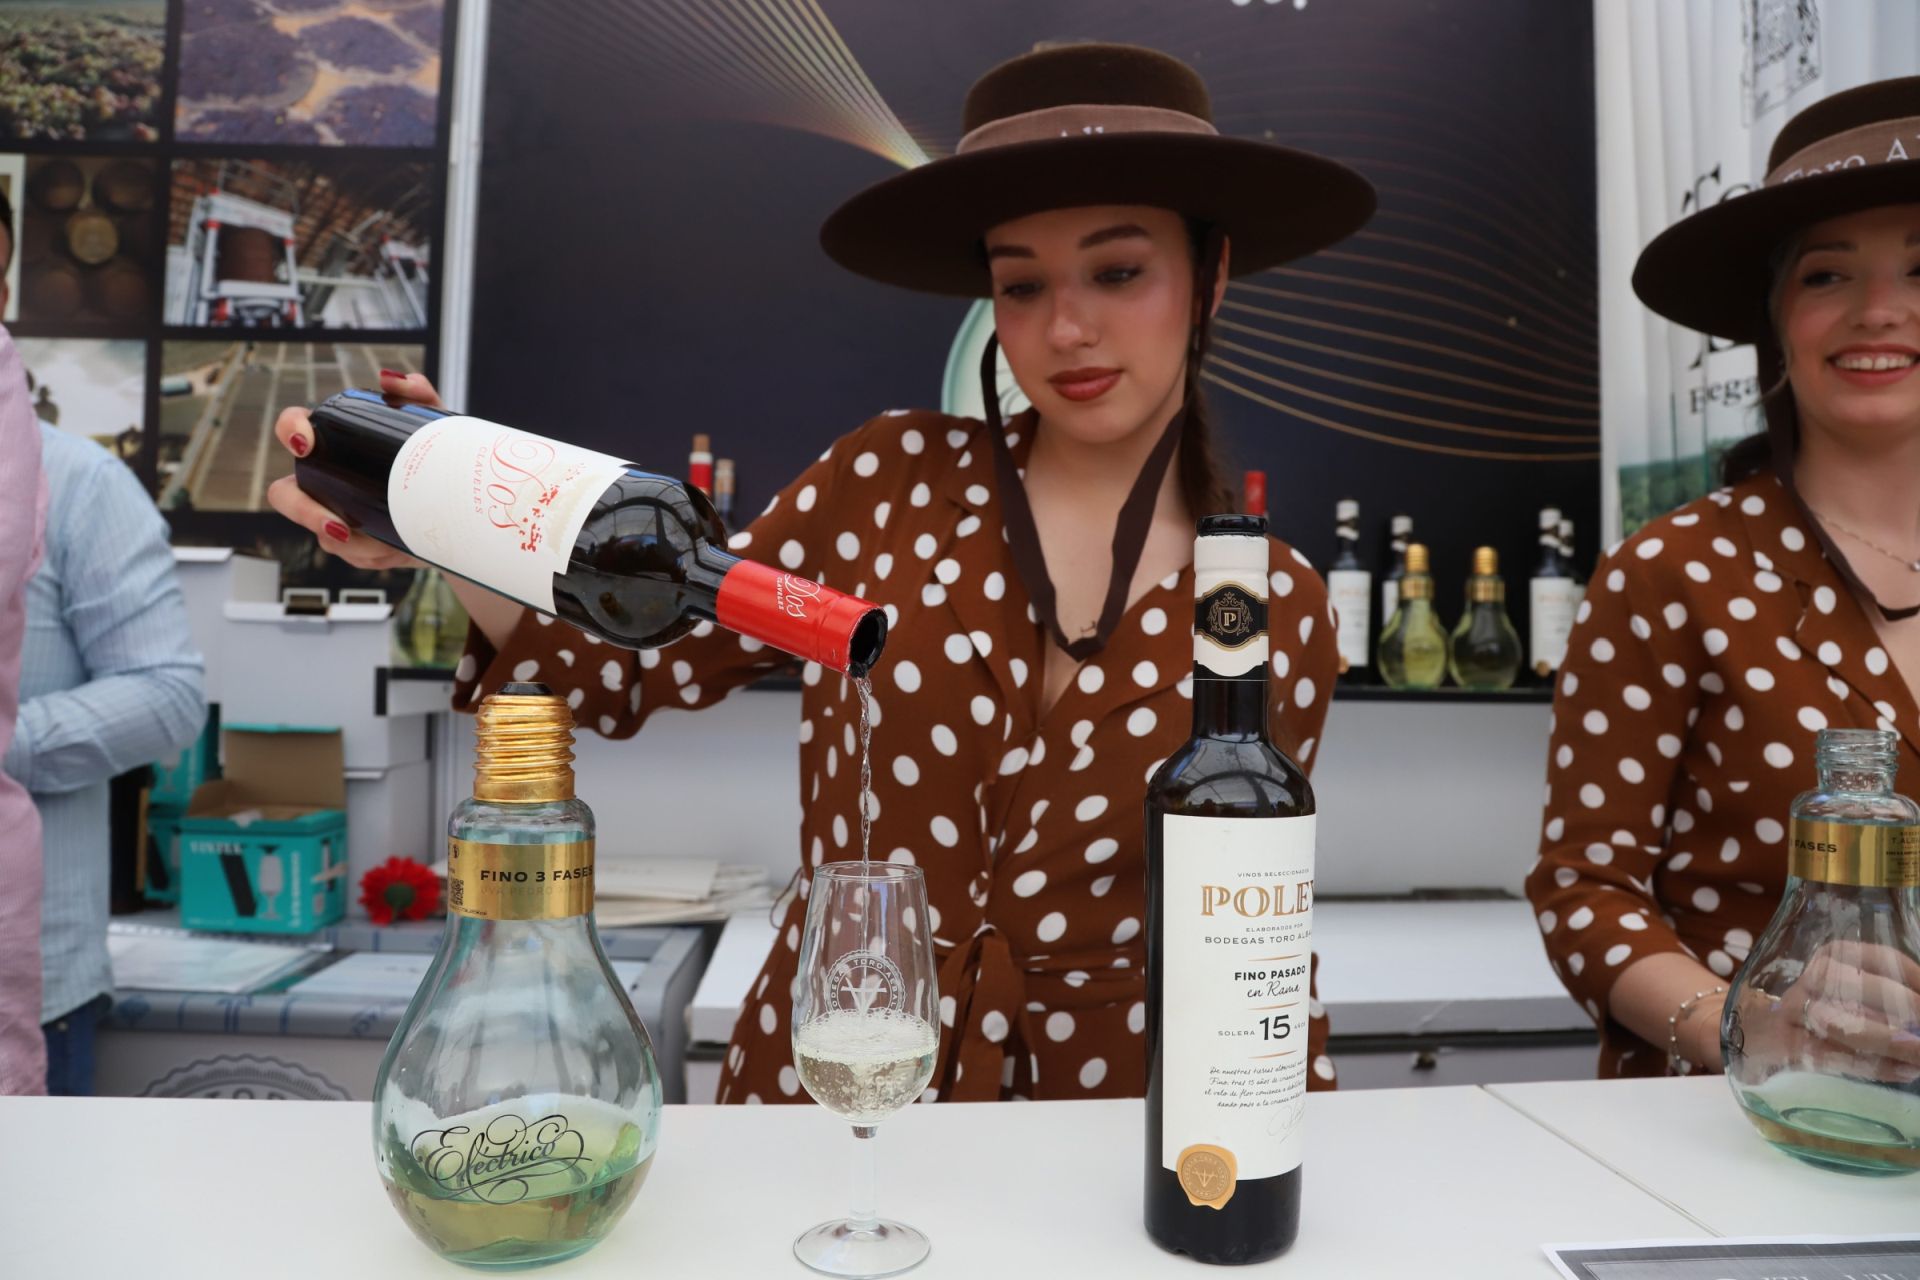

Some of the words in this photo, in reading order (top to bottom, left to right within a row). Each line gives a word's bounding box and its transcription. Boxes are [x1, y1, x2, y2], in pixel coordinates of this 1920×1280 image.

[471, 446, 488, 514] CLAVELES
[776, 576, 785, 611] CLAVELES
[784, 573, 821, 618] Dos
[1223, 612, 1237, 627] P
[1794, 839, 1838, 853] FASES
[480, 869, 529, 883] FINO
[535, 871, 546, 882] 3
[552, 865, 593, 882] FASES
[1246, 924, 1292, 933] ELABORADOS
[1204, 936, 1265, 945] BODEGAS
[1270, 934, 1296, 943] TORO
[854, 959, 883, 970] TORO
[1234, 971, 1267, 981] FINO
[1271, 965, 1306, 979] PASADO
[1247, 988, 1264, 998] en
[1265, 980, 1301, 997] Rama
[1259, 1014, 1291, 1041] 15
[1239, 1088, 1254, 1100] flor
